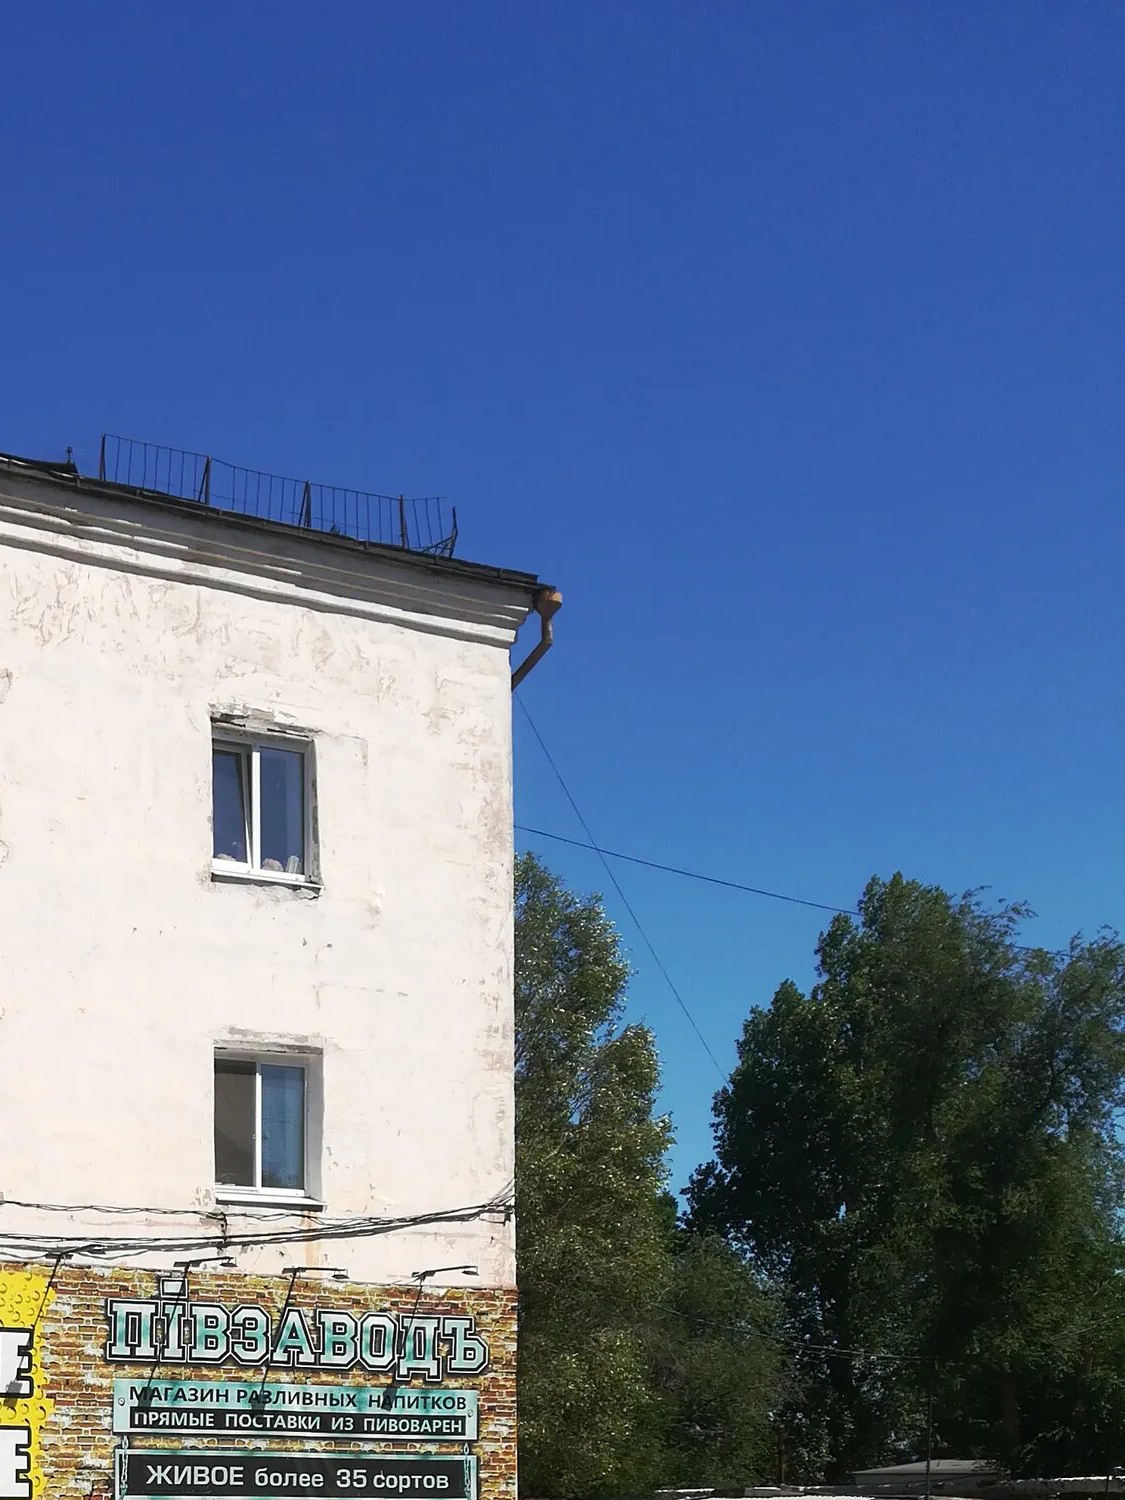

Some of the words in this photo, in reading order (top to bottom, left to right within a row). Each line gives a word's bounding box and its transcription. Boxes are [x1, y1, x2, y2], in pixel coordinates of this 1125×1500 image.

[106, 1277, 488, 1382] ПІВЗАВОДЪ
[129, 1385, 229, 1404] МАГАЗИН
[236, 1389, 357, 1408] РАЗЛИВНЫХ
[368, 1393, 467, 1411] НАПИТКОВ
[134, 1410, 215, 1428] ПРЯМЫЕ
[225, 1413, 321, 1431] ПОСТАВКИ
[331, 1416, 354, 1431] ИЗ
[363, 1417, 463, 1434] ПИВОВАРЕН
[146, 1464, 244, 1486] ЖИВОЕ
[254, 1466, 324, 1488] более
[336, 1468, 367, 1488] 35
[373, 1471, 449, 1494] сортов
